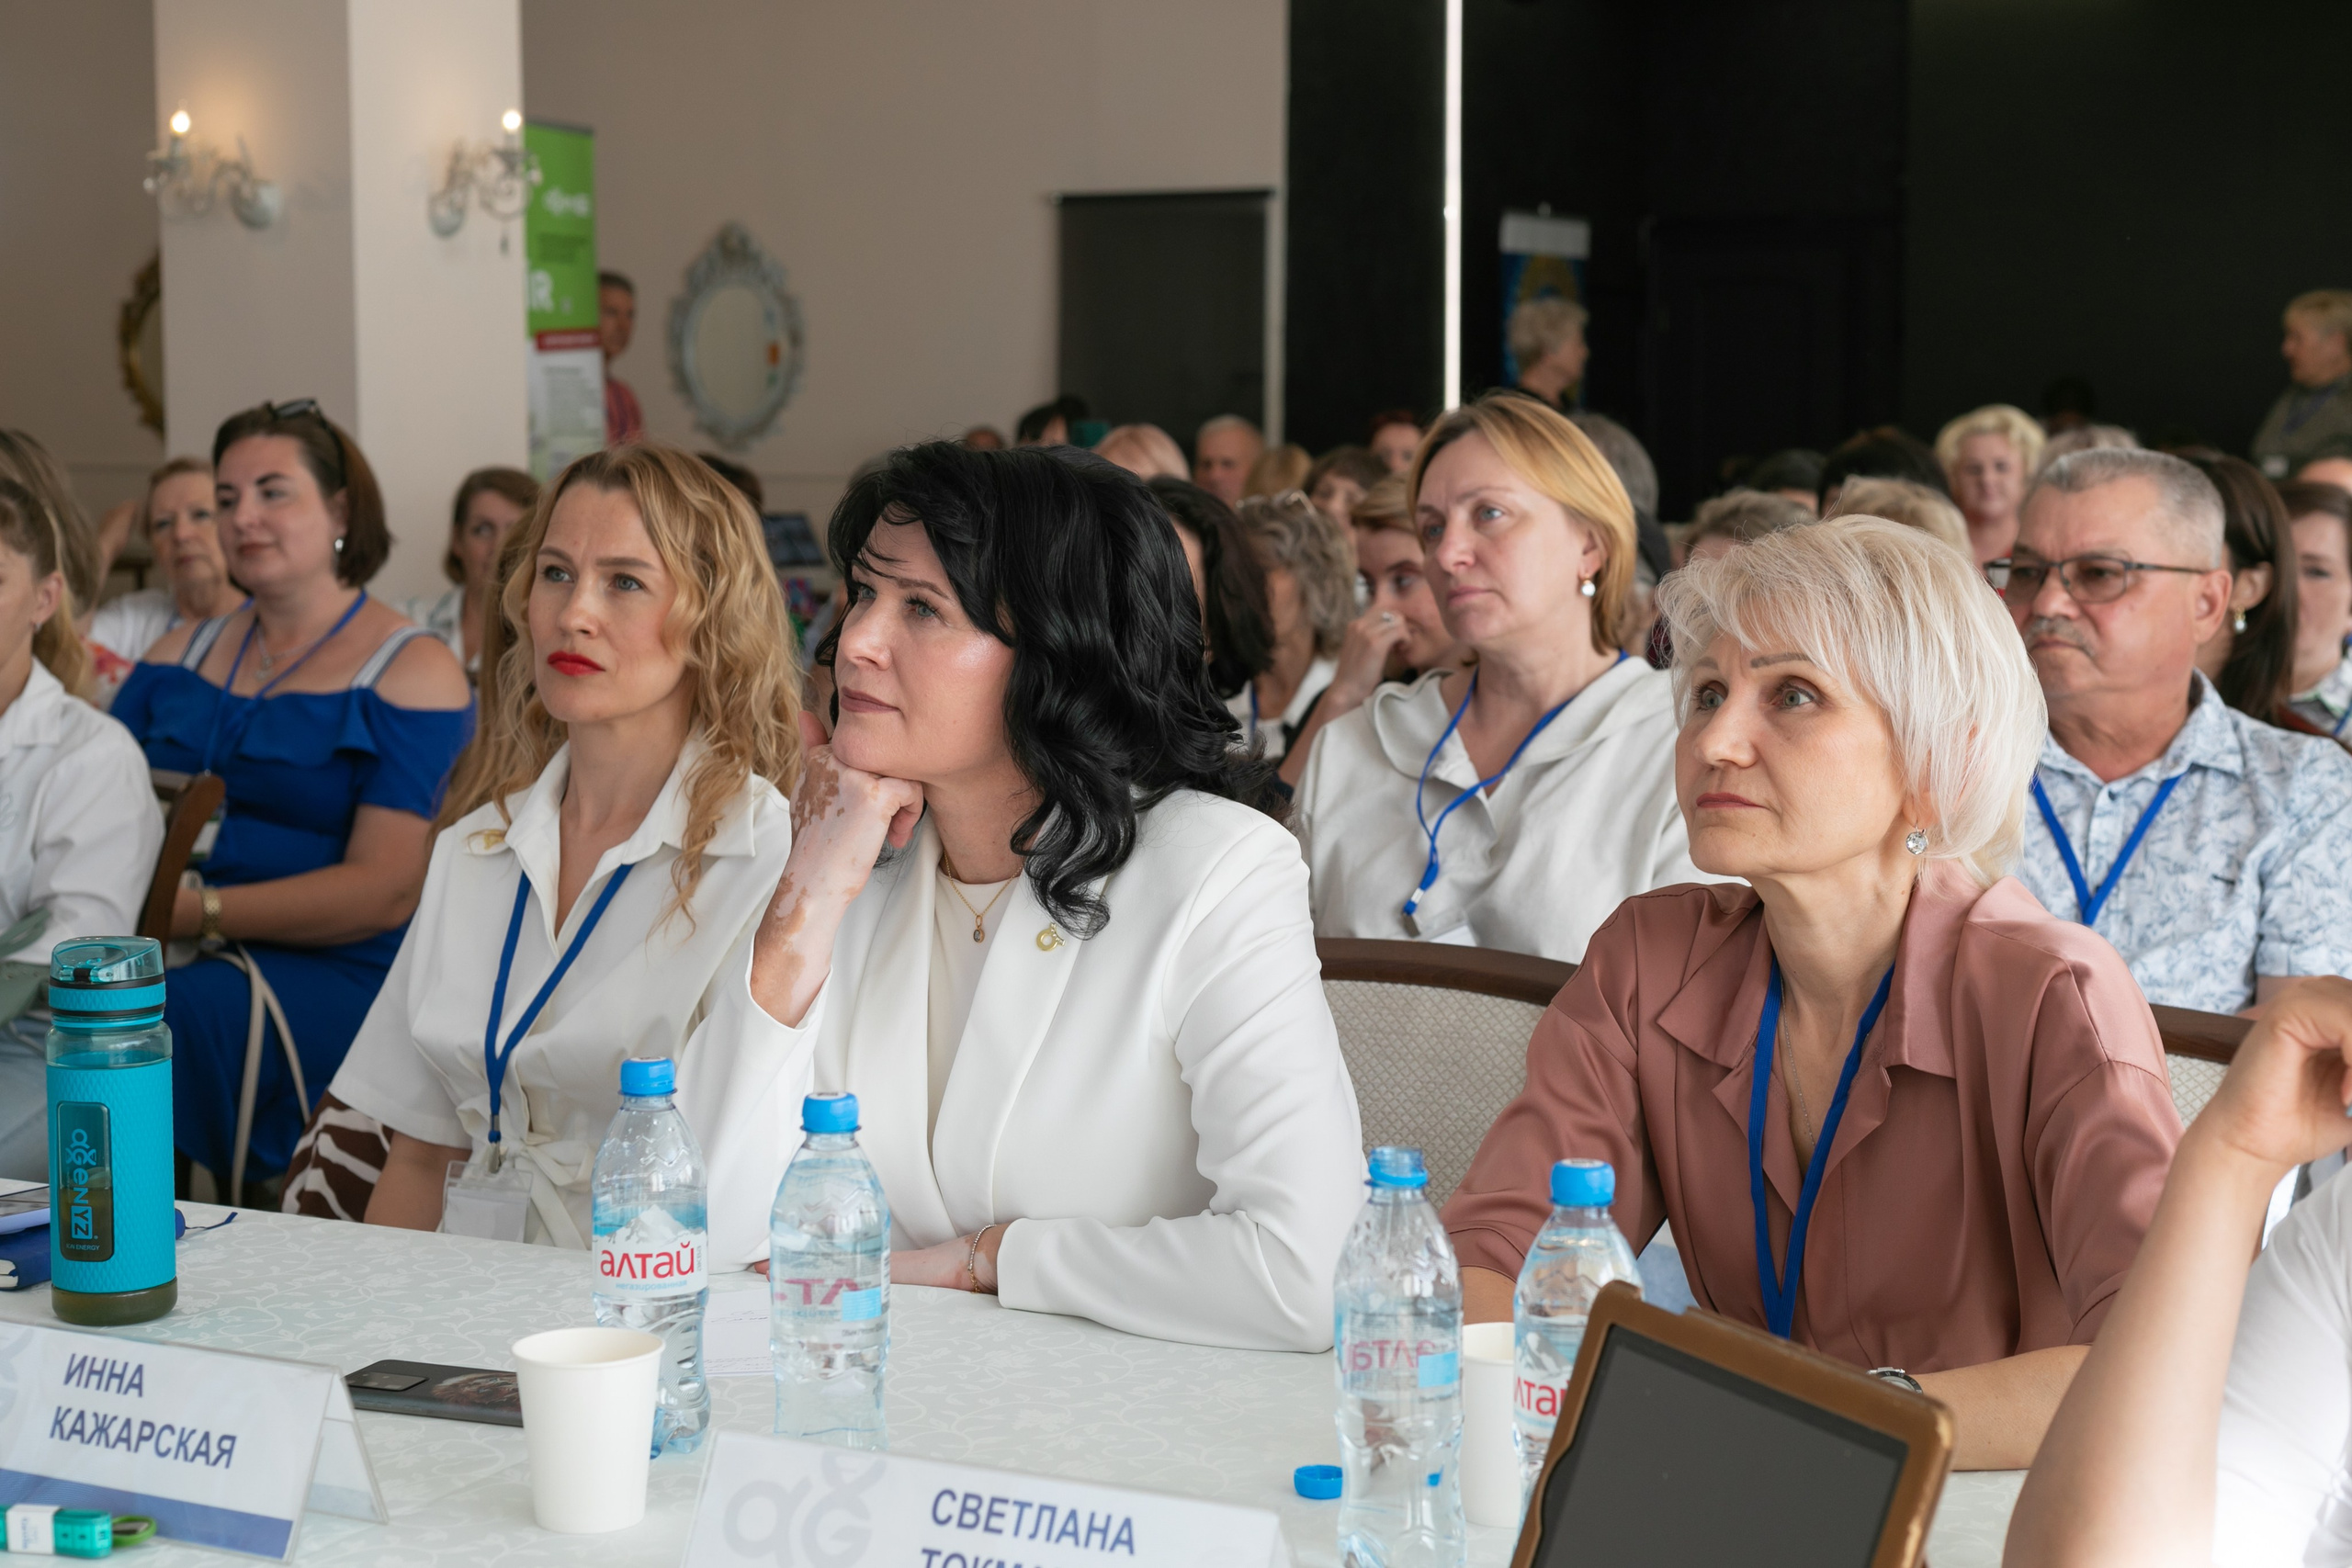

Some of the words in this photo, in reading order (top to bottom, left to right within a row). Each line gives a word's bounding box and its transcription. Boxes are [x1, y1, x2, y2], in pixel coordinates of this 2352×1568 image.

[75, 1243, 100, 1251] ENERGY
[600, 1241, 695, 1279] алтай
[63, 1353, 144, 1398] ИННА
[1514, 1376, 1570, 1416] лта
[50, 1405, 237, 1469] КАЖАРСКАЯ
[932, 1488, 1136, 1555] СВЕТЛАНА
